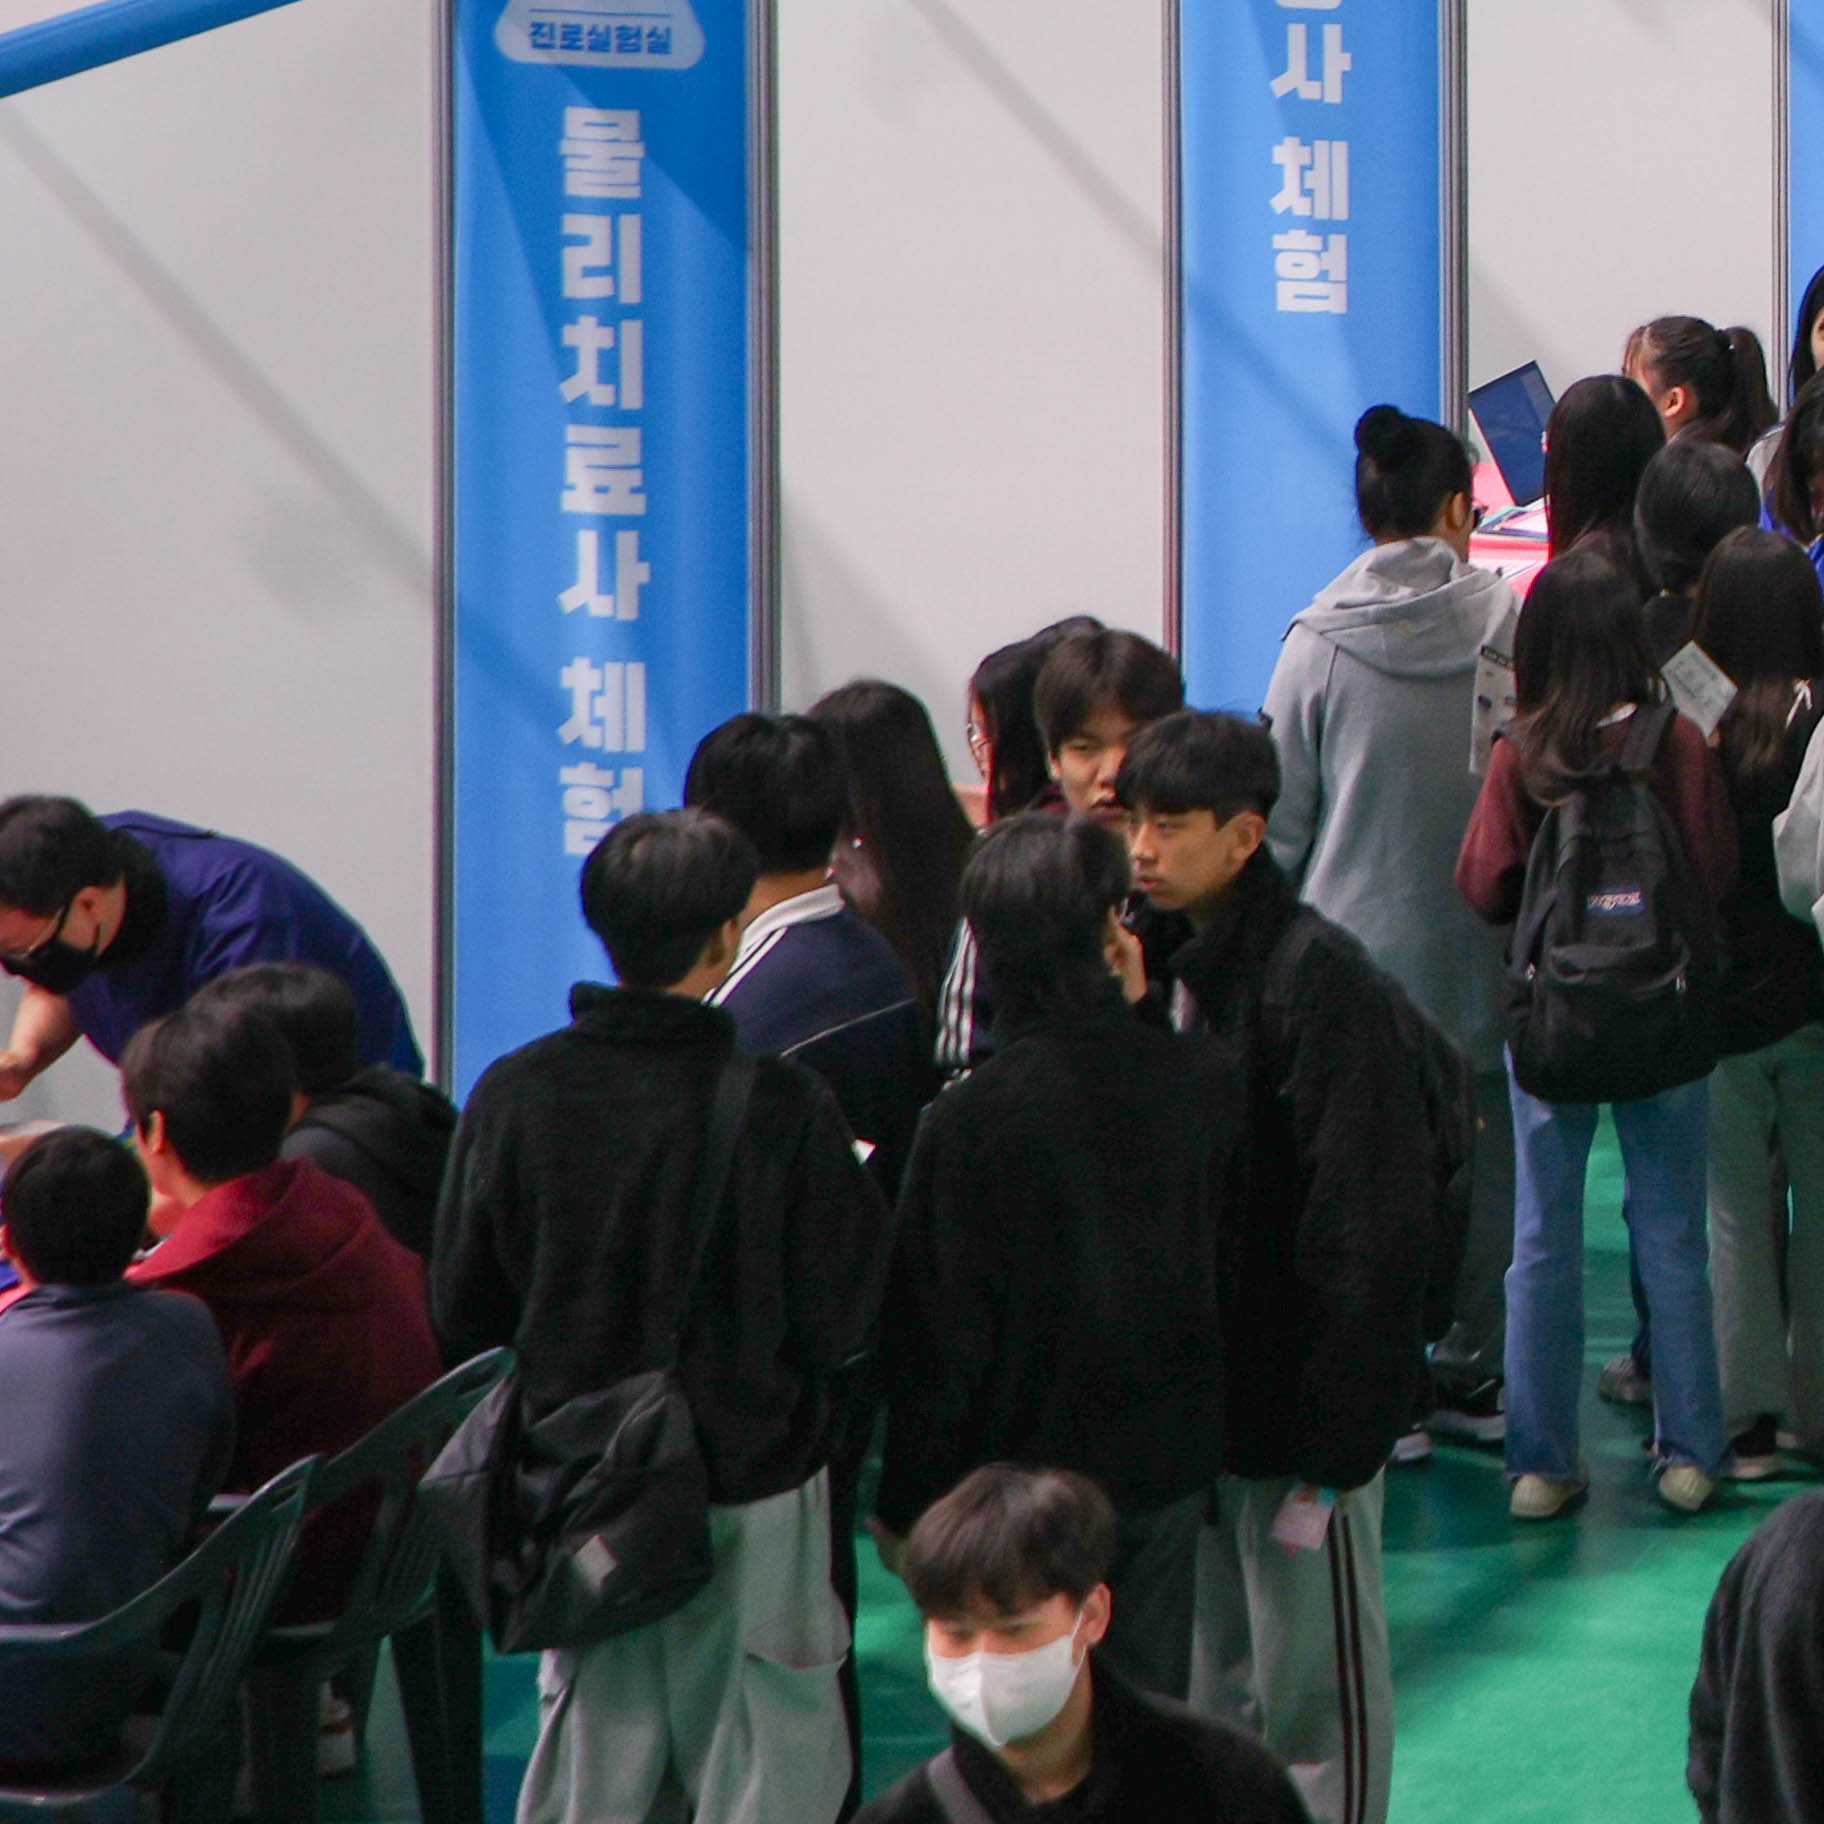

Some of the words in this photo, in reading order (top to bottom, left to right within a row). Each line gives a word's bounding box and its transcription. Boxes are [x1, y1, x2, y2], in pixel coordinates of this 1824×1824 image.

[528, 21, 672, 56] 진로실험실
[1270, 136, 1349, 315] 체험
[559, 105, 650, 620] 물리치료사
